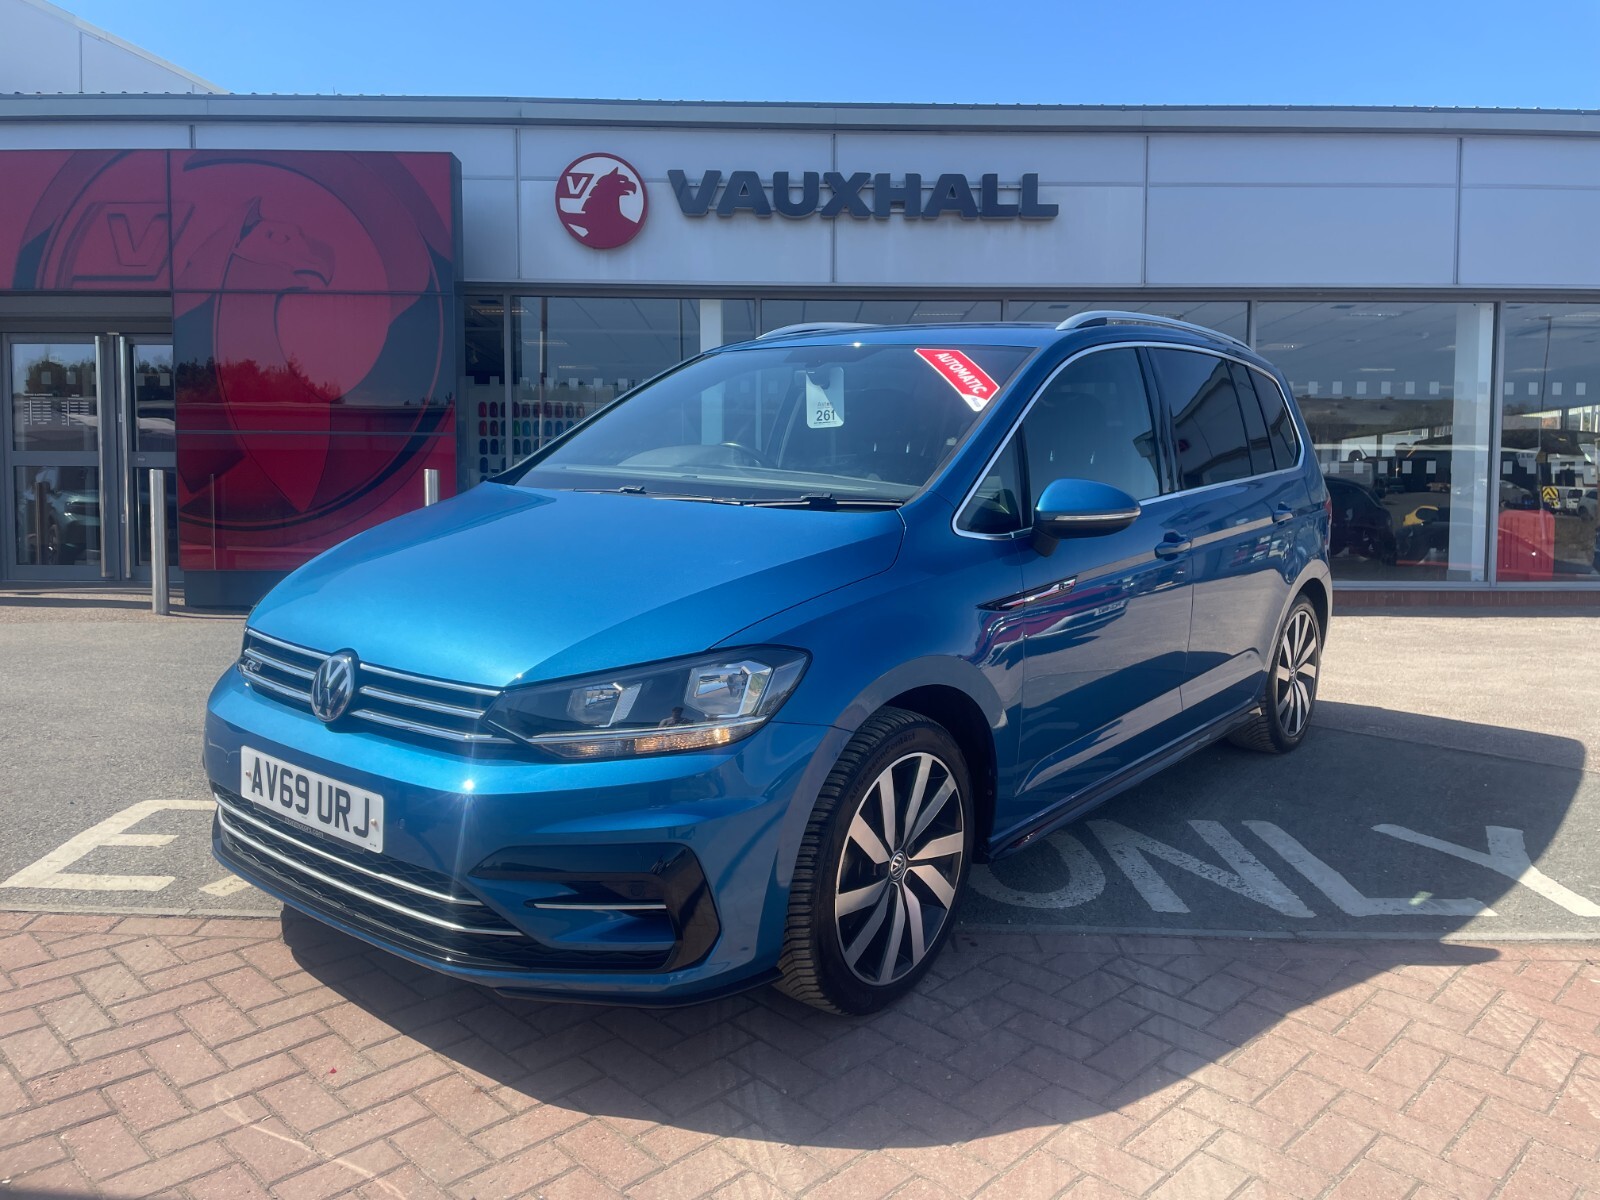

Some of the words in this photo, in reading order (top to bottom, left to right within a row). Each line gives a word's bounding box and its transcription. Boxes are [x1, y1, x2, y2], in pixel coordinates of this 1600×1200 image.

[667, 169, 1059, 219] VAUXHALL
[934, 352, 988, 394] AUTOMATIC
[816, 409, 835, 421] 261
[251, 756, 310, 816] AV69
[317, 780, 370, 839] URJ
[966, 818, 1599, 918] ONLY
